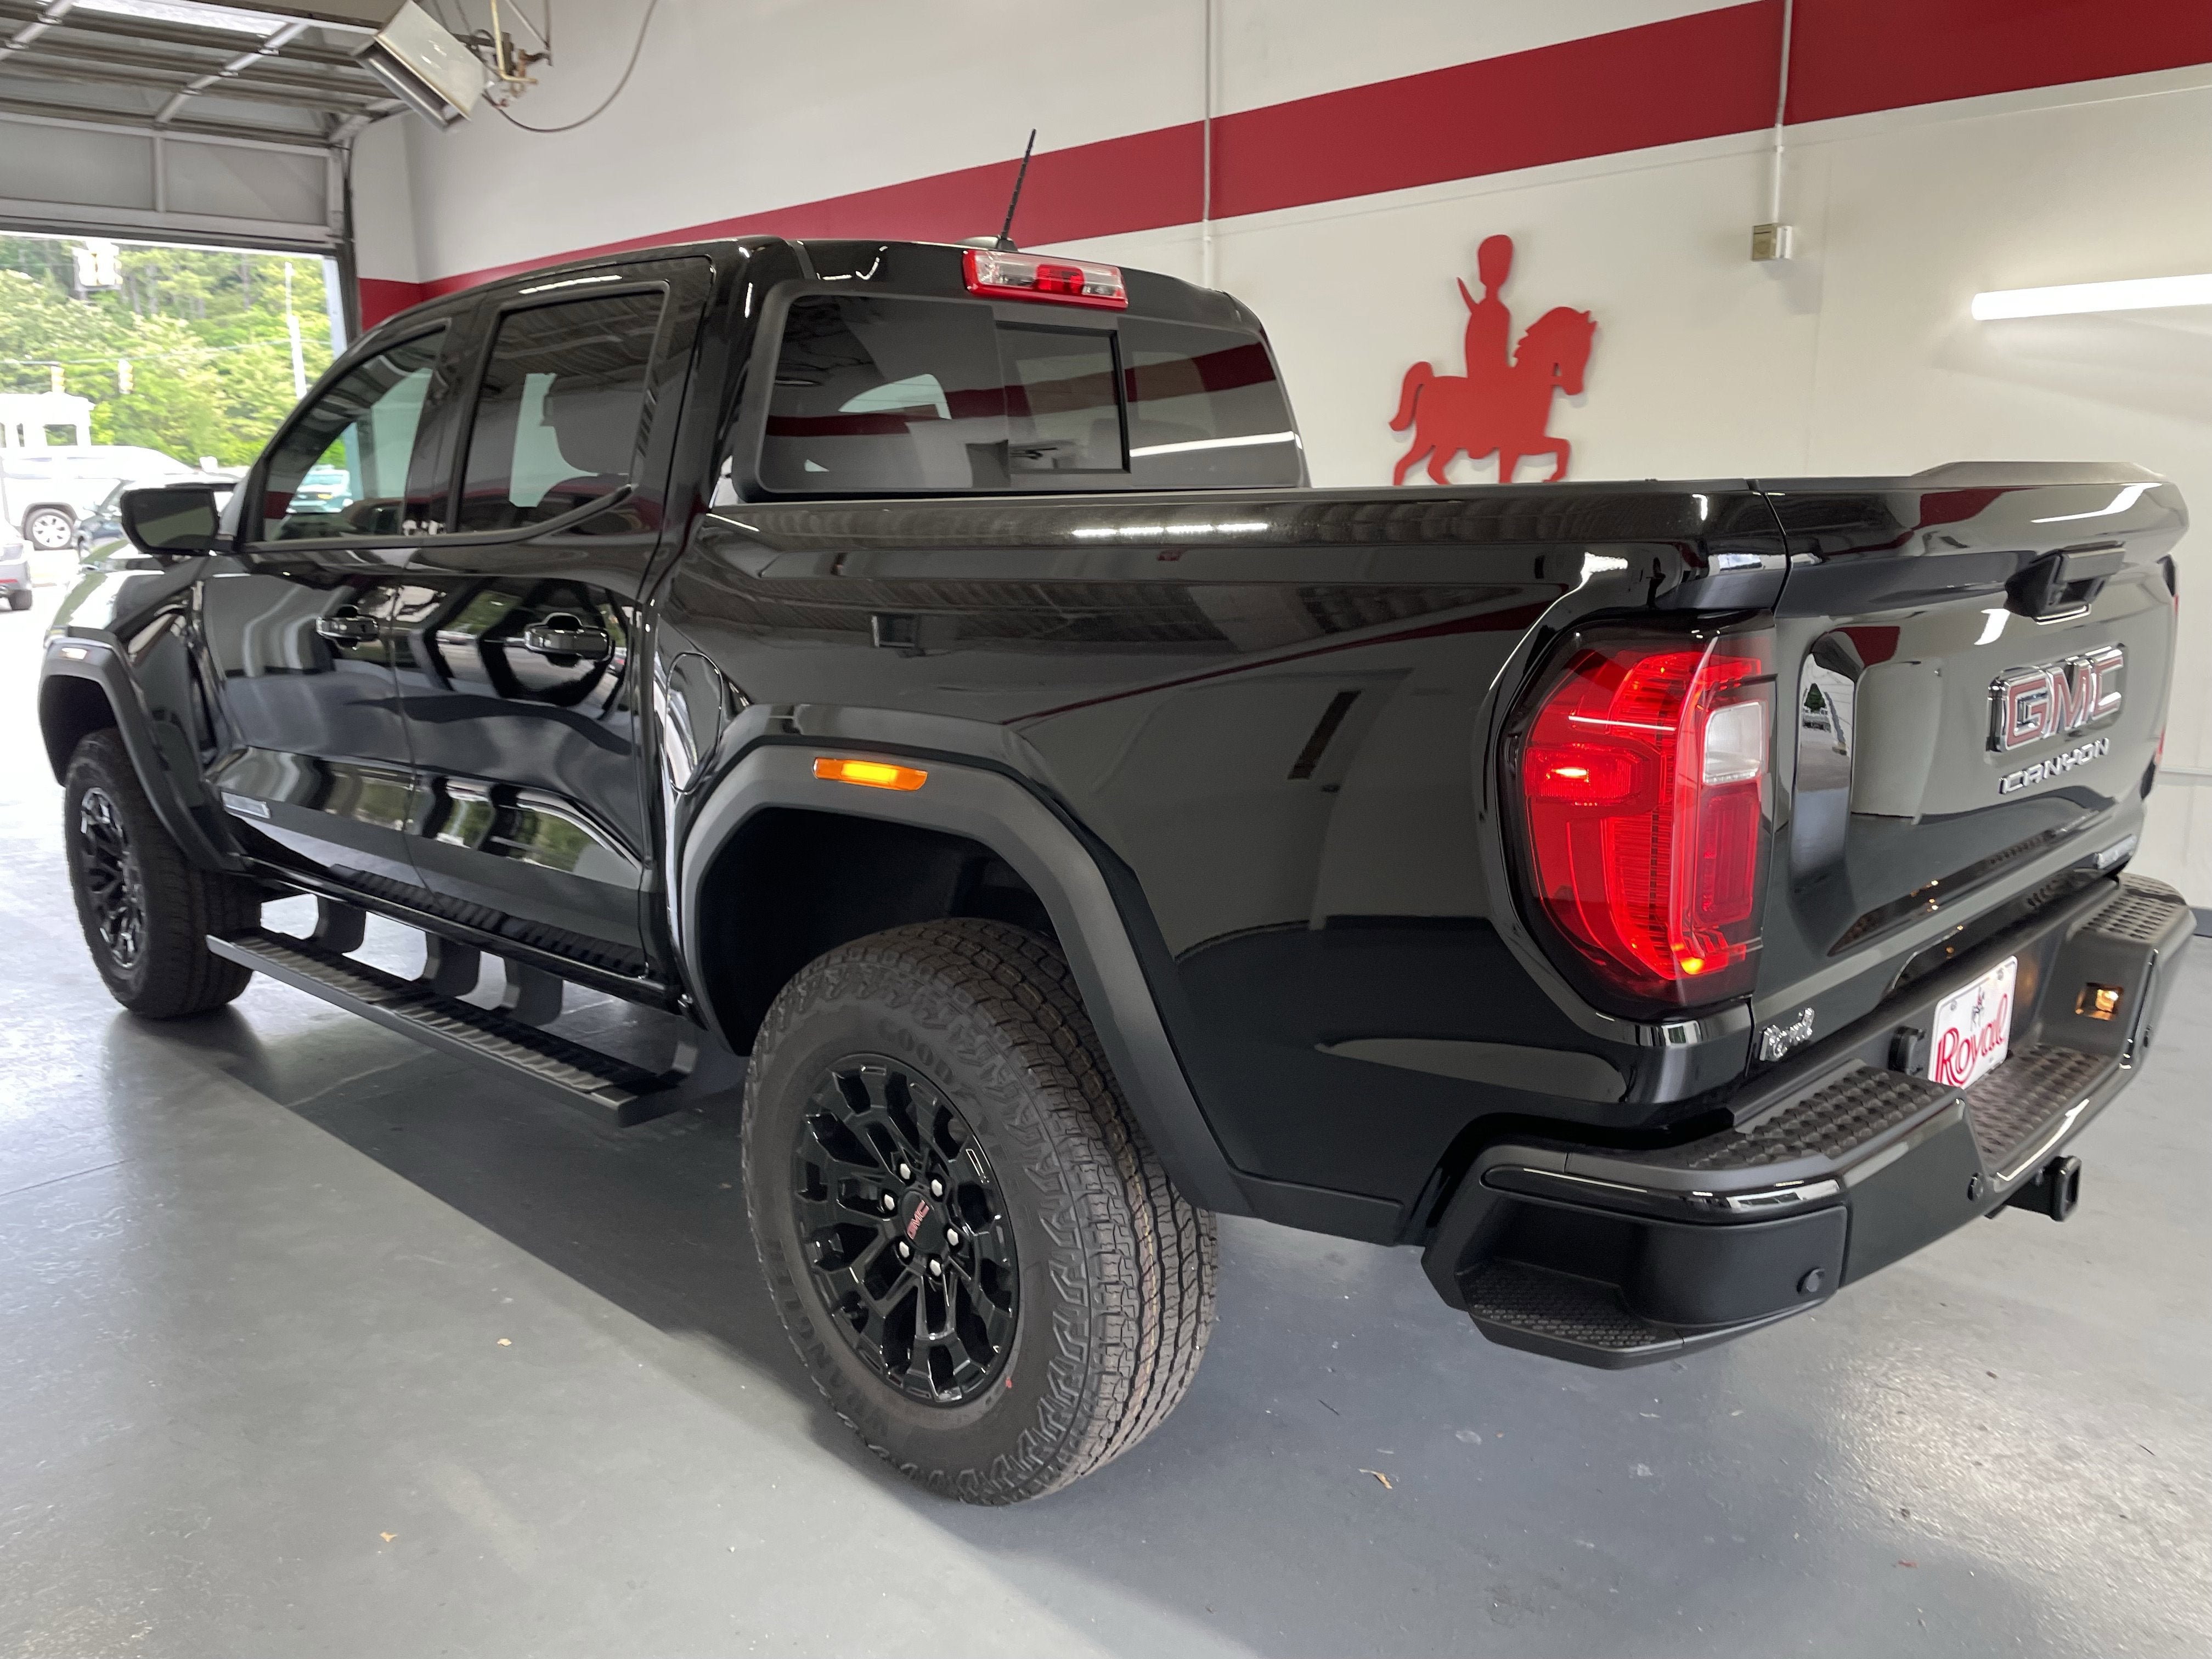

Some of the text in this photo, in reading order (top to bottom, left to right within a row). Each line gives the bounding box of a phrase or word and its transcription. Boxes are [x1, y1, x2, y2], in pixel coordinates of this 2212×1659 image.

[1996, 647, 2124, 751] GMC
[1999, 737, 2111, 794] CANYON
[1936, 993, 2008, 1087] Royal
[906, 1199, 930, 1240] GMC
